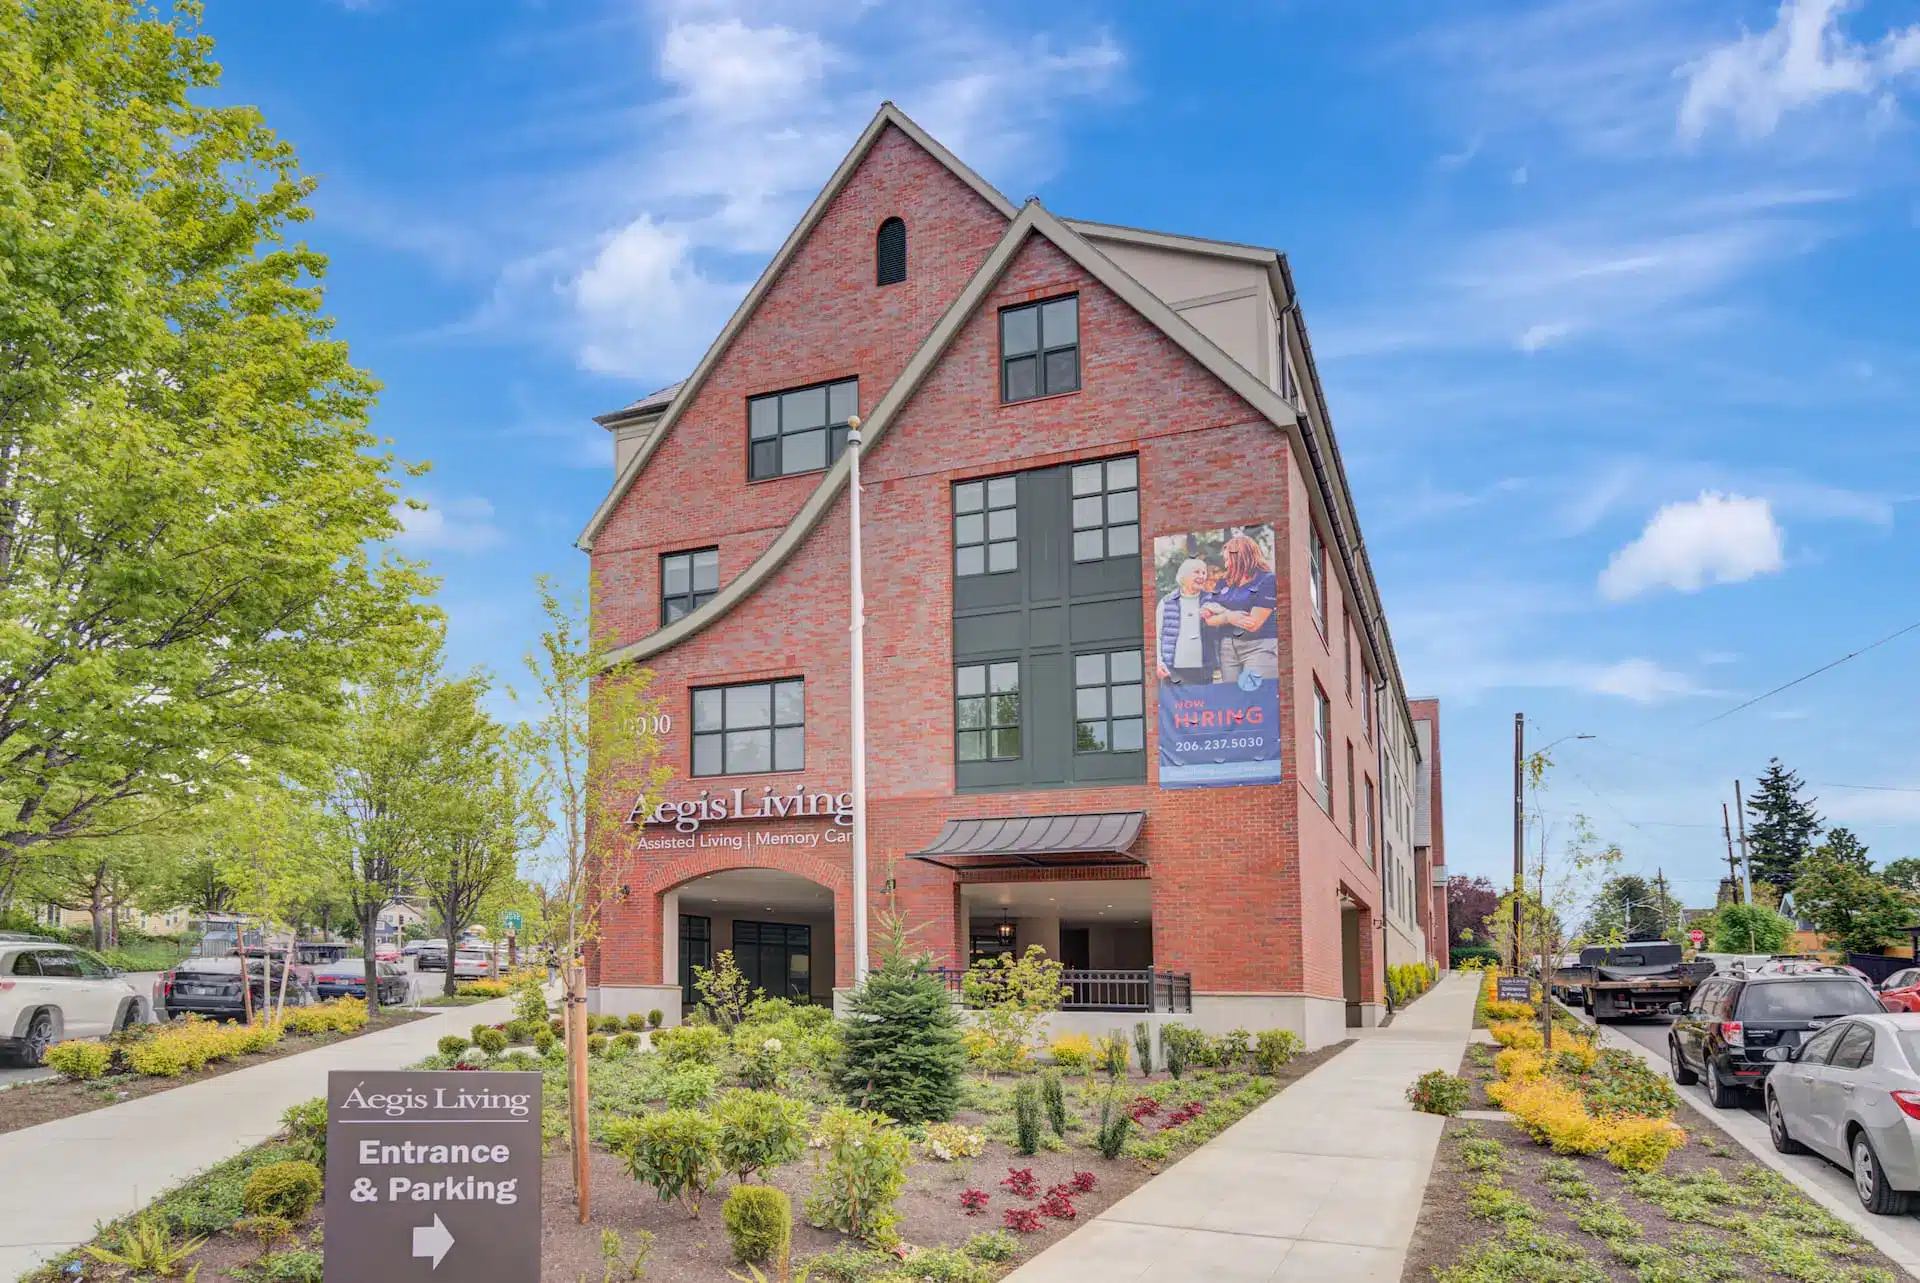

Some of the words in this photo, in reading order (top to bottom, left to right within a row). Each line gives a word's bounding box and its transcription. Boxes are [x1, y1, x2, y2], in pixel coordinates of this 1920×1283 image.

[1174, 706, 1263, 729] HIRING
[1175, 736, 1263, 752] 206.237.5030
[730, 784, 854, 826] Living
[637, 834, 695, 850] Assisted
[700, 833, 742, 850] Living
[755, 830, 820, 848] Memory
[824, 828, 854, 843] Car
[433, 1087, 531, 1116] Living
[359, 1140, 510, 1165] Entrance
[350, 1177, 378, 1203] &
[389, 1175, 518, 1205] Parking
